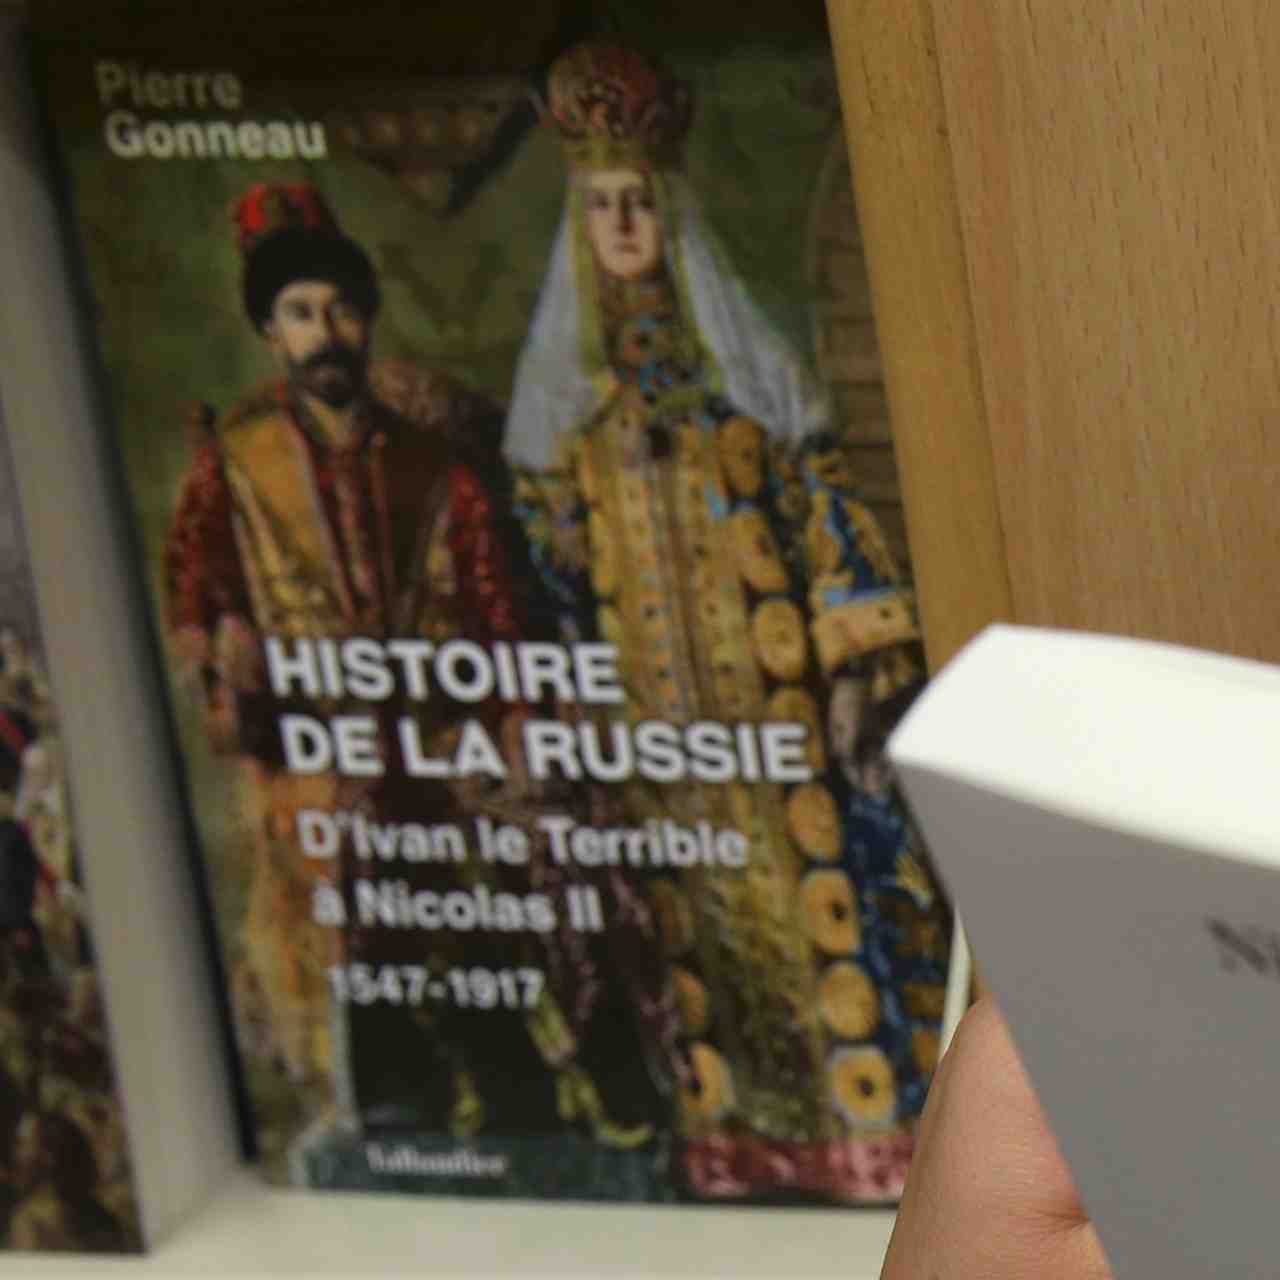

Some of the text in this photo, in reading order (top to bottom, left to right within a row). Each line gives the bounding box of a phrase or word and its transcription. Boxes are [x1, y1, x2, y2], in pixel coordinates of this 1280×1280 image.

[96, 61, 242, 109] Pierre
[106, 112, 326, 158] Gonneau
[266, 638, 624, 701] HISTOIRE
[280, 714, 812, 783] DE LA RUSSIE
[297, 809, 749, 867] D'Ivan le Terrible
[355, 879, 556, 932] Nicolas
[566, 884, 603, 932] II
[329, 964, 545, 1008] 1547-1917
